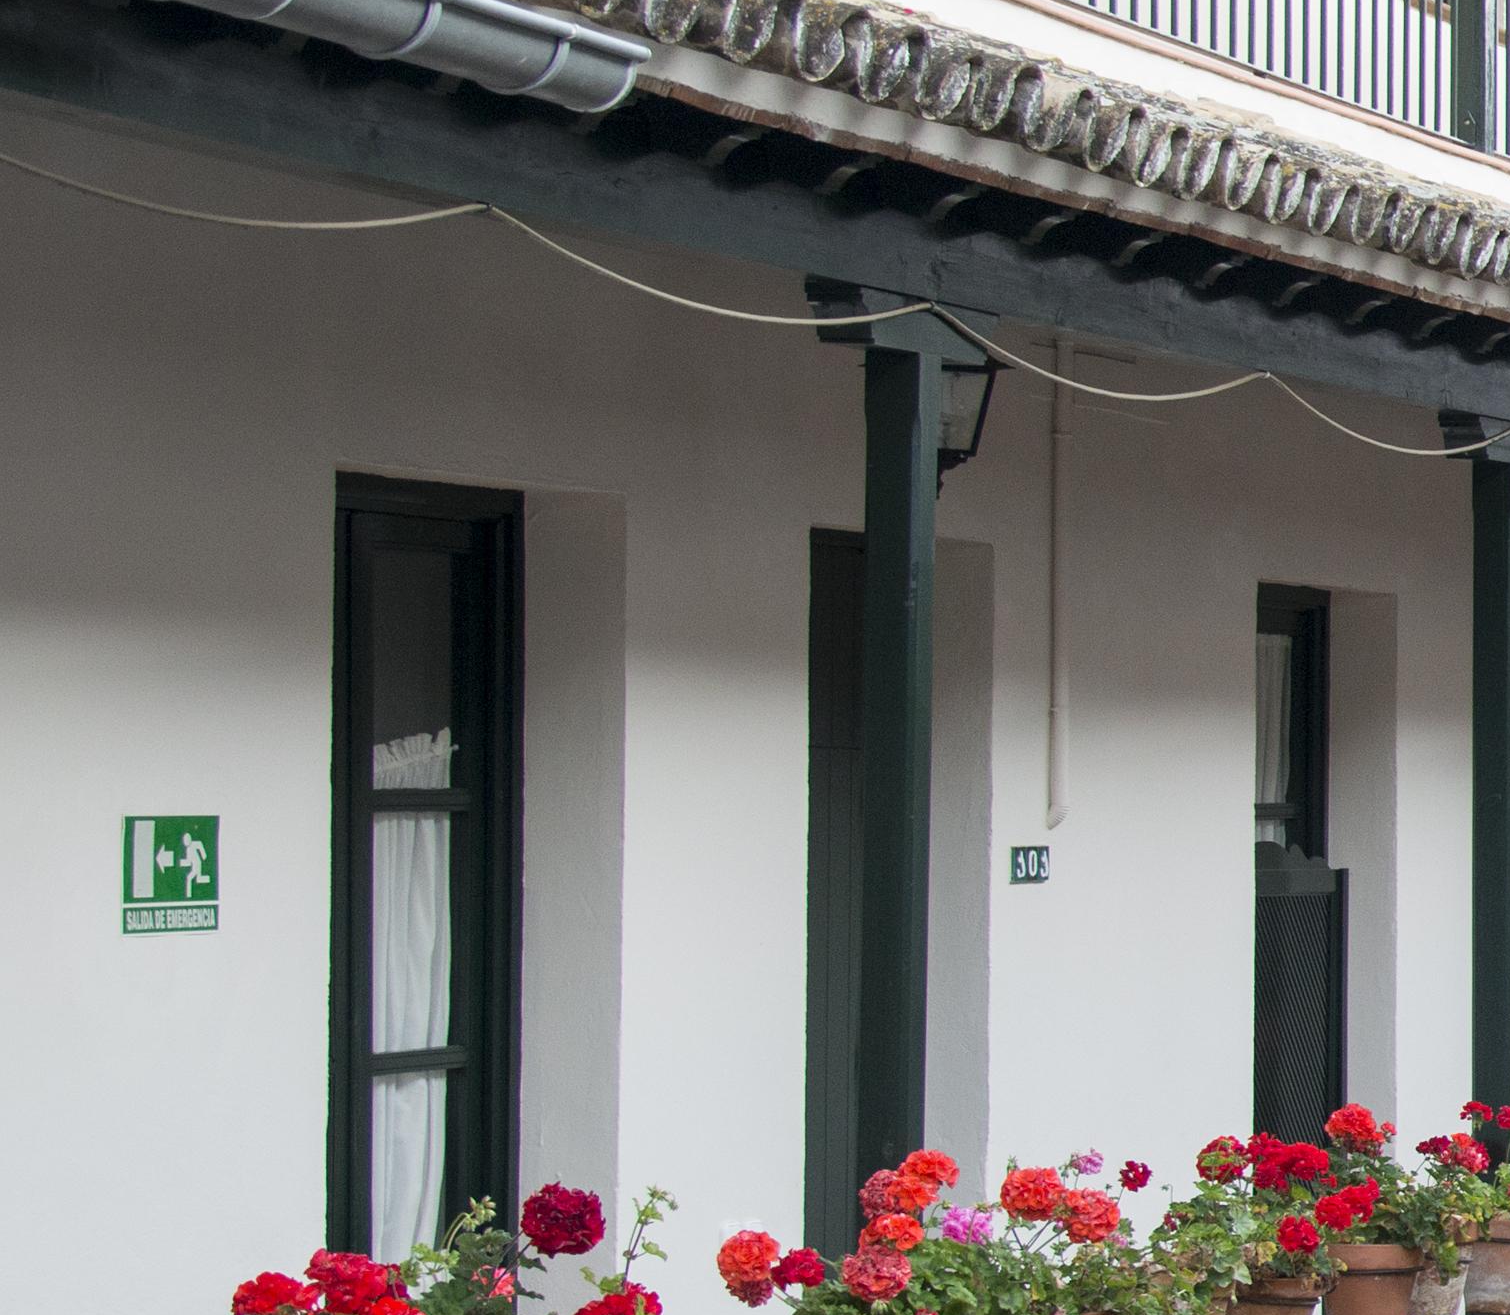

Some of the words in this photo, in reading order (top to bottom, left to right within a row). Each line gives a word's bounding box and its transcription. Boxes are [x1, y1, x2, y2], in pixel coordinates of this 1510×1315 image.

[126, 910, 154, 930] SALIDA
[155, 909, 166, 929] DE
[166, 908, 216, 929] EMERGENCIA
